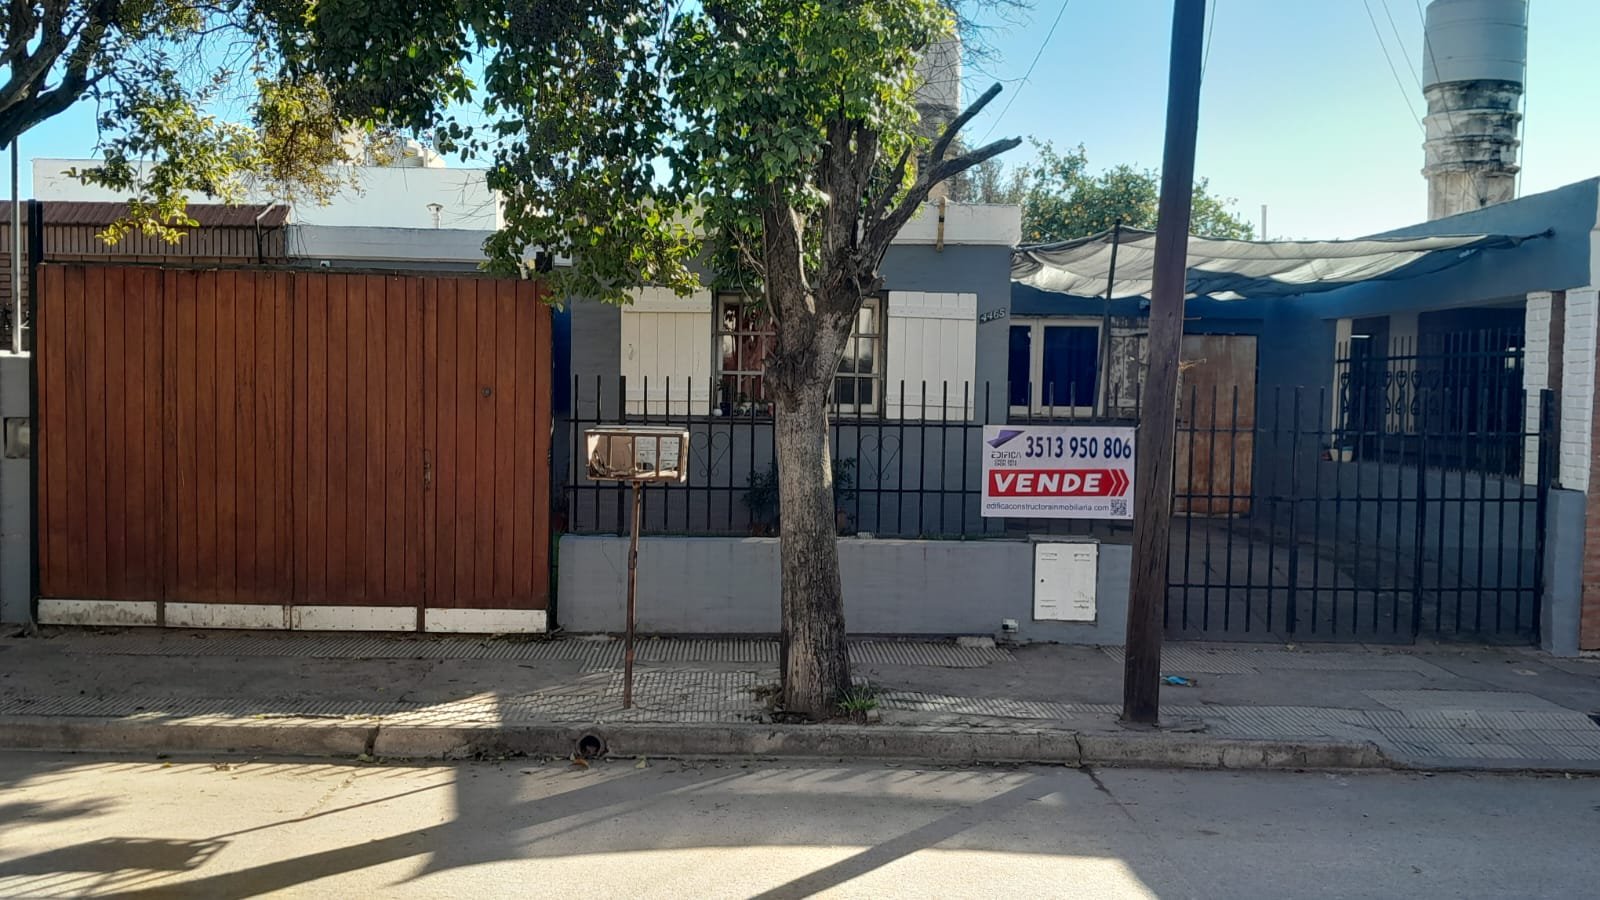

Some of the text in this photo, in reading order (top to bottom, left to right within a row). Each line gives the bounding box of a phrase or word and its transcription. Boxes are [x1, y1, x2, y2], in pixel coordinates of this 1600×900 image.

[980, 307, 1006, 322] 4465
[991, 451, 1022, 459] EDIFICA
[1025, 436, 1132, 459] 3513 950 806
[994, 473, 1103, 493] VENDE
